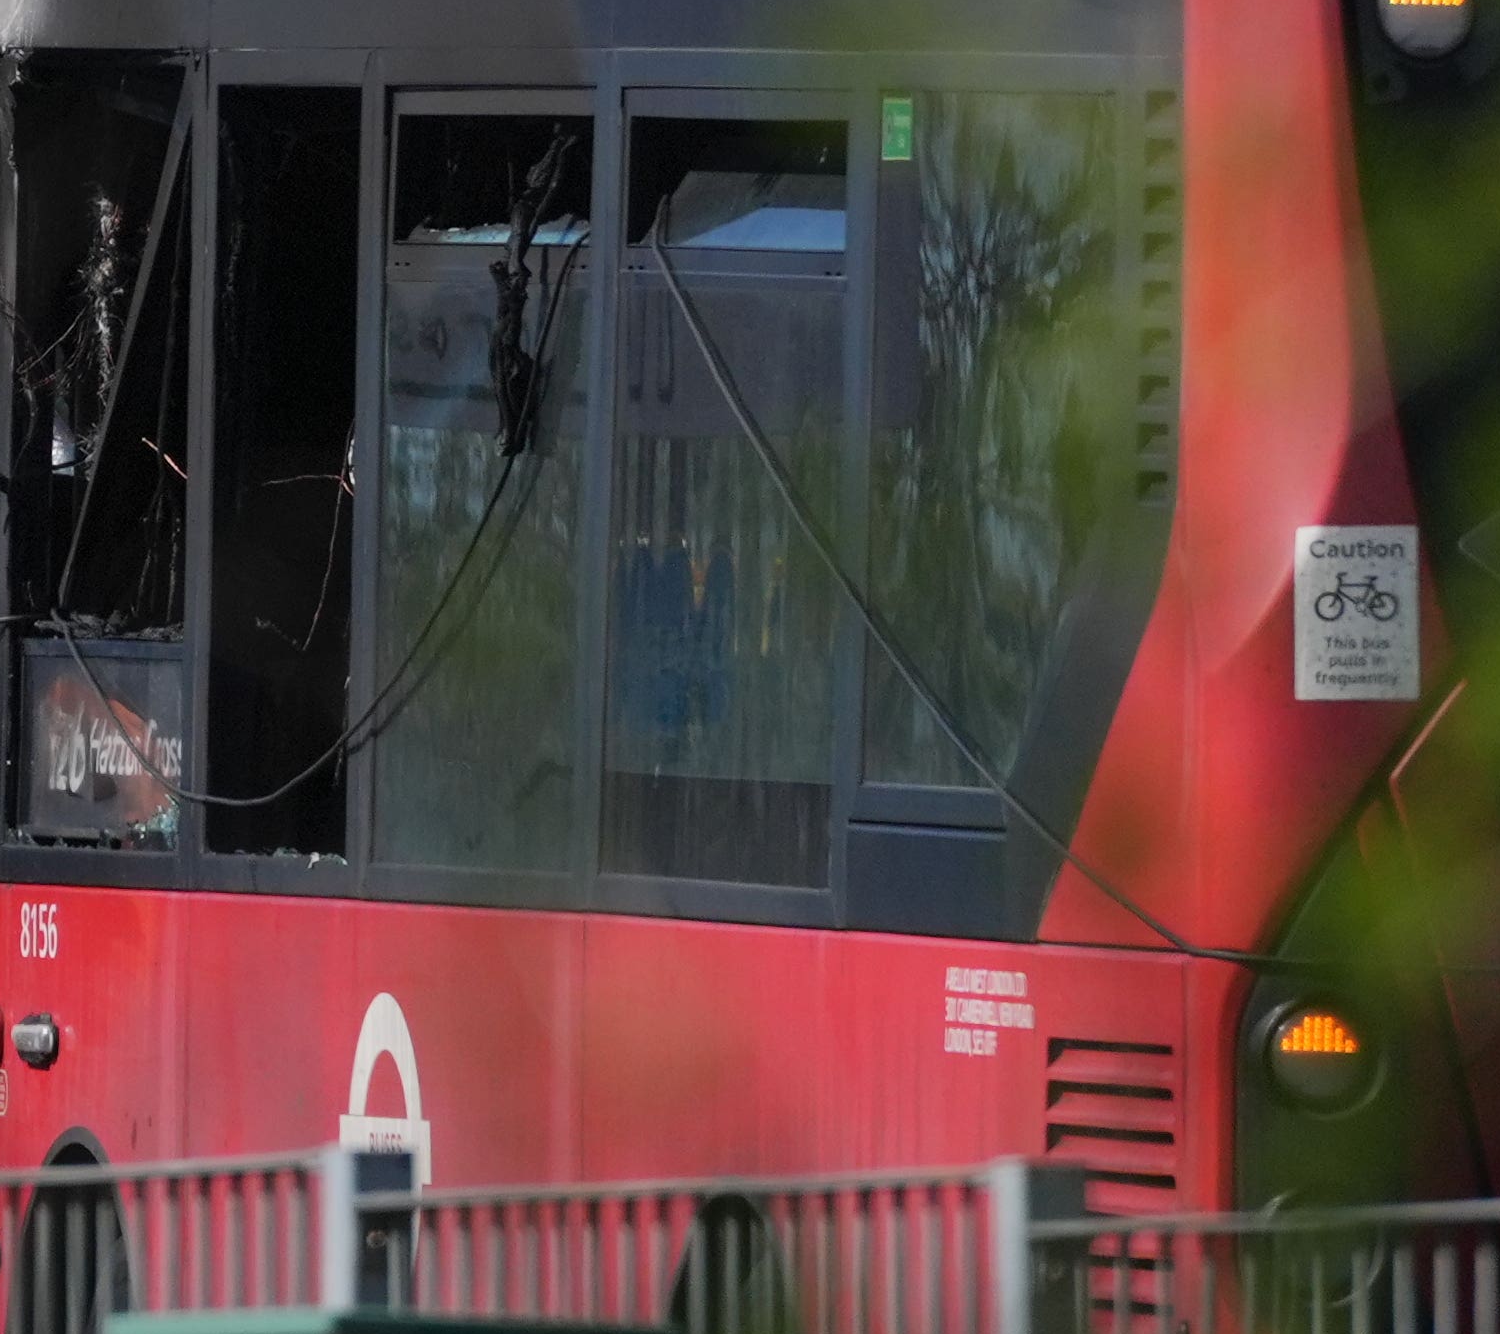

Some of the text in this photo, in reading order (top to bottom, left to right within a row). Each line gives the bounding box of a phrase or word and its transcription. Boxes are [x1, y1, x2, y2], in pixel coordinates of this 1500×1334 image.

[1309, 539, 1405, 559] Caution
[1324, 635, 1390, 650] This bus
[1329, 653, 1367, 669] pulls
[1315, 670, 1398, 687] frequently
[20, 901, 58, 959] 8156
